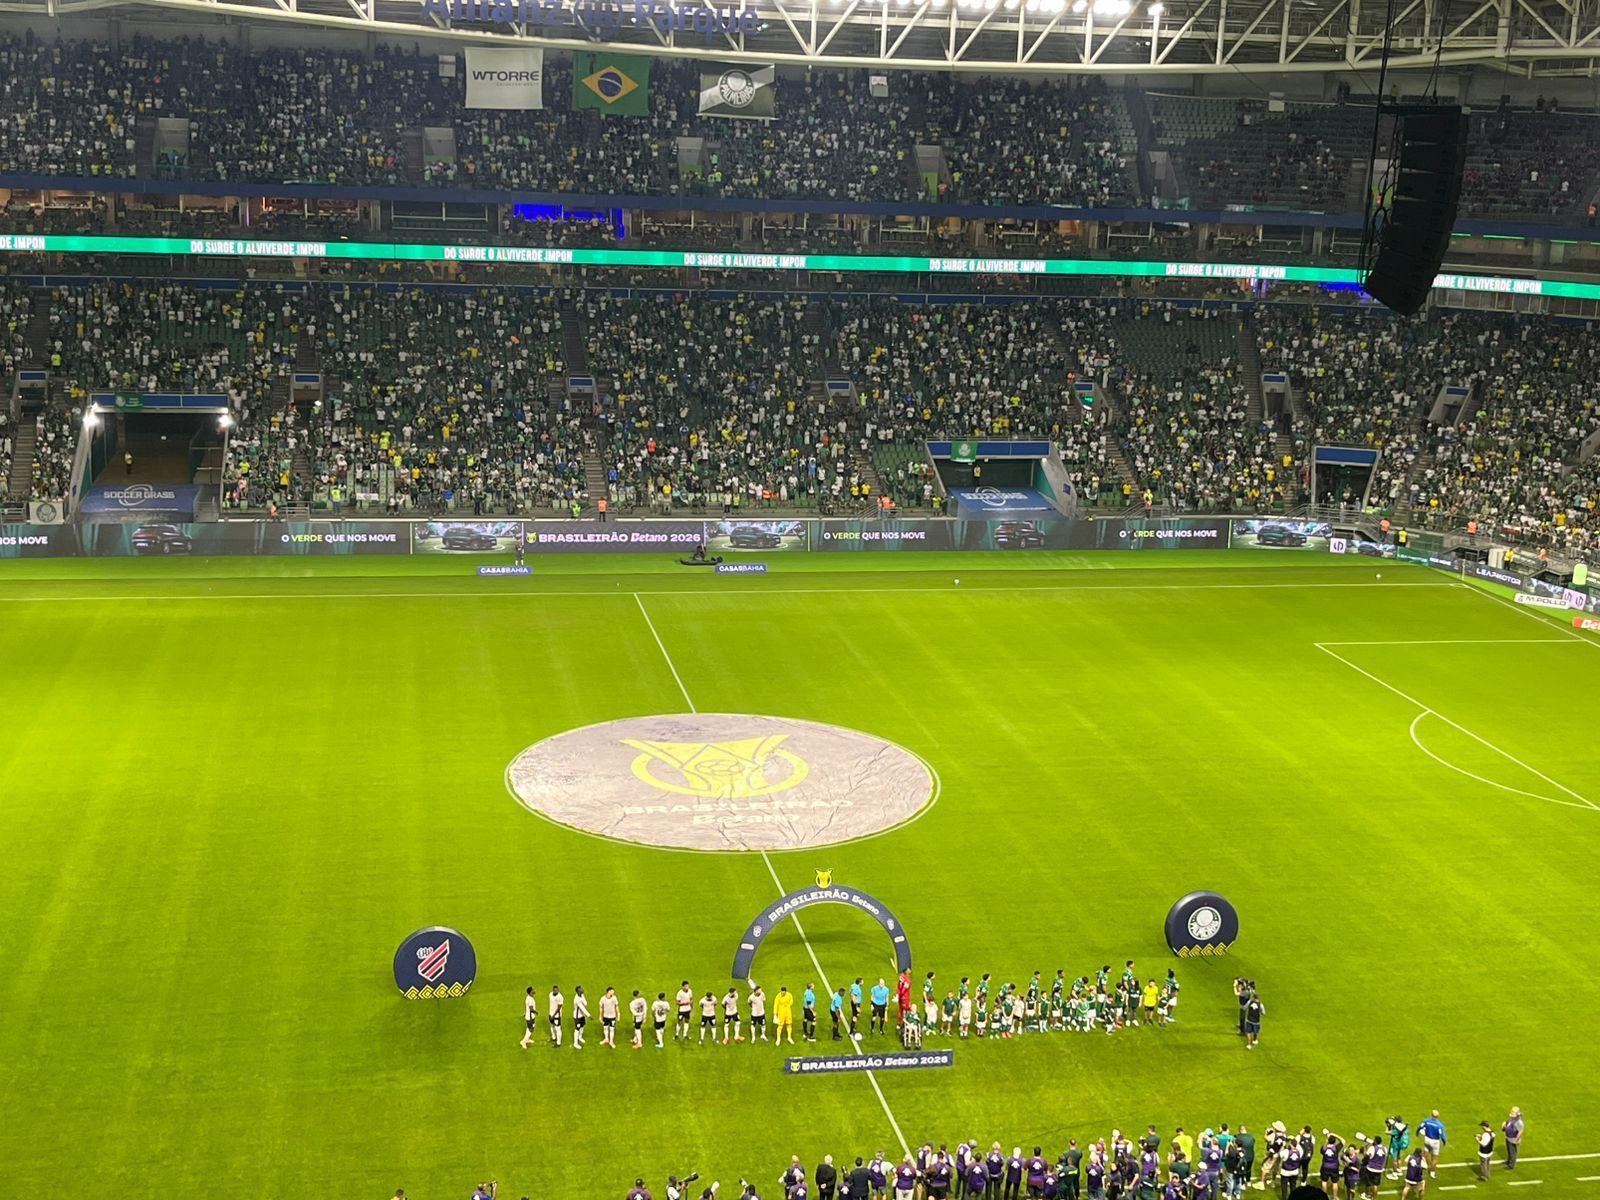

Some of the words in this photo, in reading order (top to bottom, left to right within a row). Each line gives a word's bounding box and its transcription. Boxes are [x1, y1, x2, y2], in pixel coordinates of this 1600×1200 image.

[473, 71, 539, 81] WTORRE
[1432, 275, 1455, 288] URGE
[104, 491, 142, 499] SOCCER
[144, 491, 175, 499] GRASS
[281, 534, 289, 542] O
[291, 534, 323, 542] VERDE
[324, 534, 346, 543] QUE
[347, 534, 367, 542] NOS
[368, 534, 397, 542] MOVE
[538, 532, 628, 542] BRASILEIRÃO
[630, 532, 668, 542] Betano
[670, 533, 701, 542] 2026
[862, 532, 880, 541] QUE
[881, 532, 899, 540] NOS
[1119, 530, 1127, 538] O
[1156, 530, 1173, 539] QUE
[1175, 530, 1192, 538] NOS
[1193, 530, 1217, 538] MOVE
[0, 537, 16, 545] OS
[18, 536, 48, 544] MOVE
[1476, 568, 1521, 585] LEAPMOTOR
[768, 889, 849, 922] BRASILEIRÃO
[851, 894, 880, 915] Betano
[801, 1057, 882, 1071] BRASILEIRÃO
[884, 1057, 918, 1067] Betano
[920, 1055, 948, 1065] 2026
